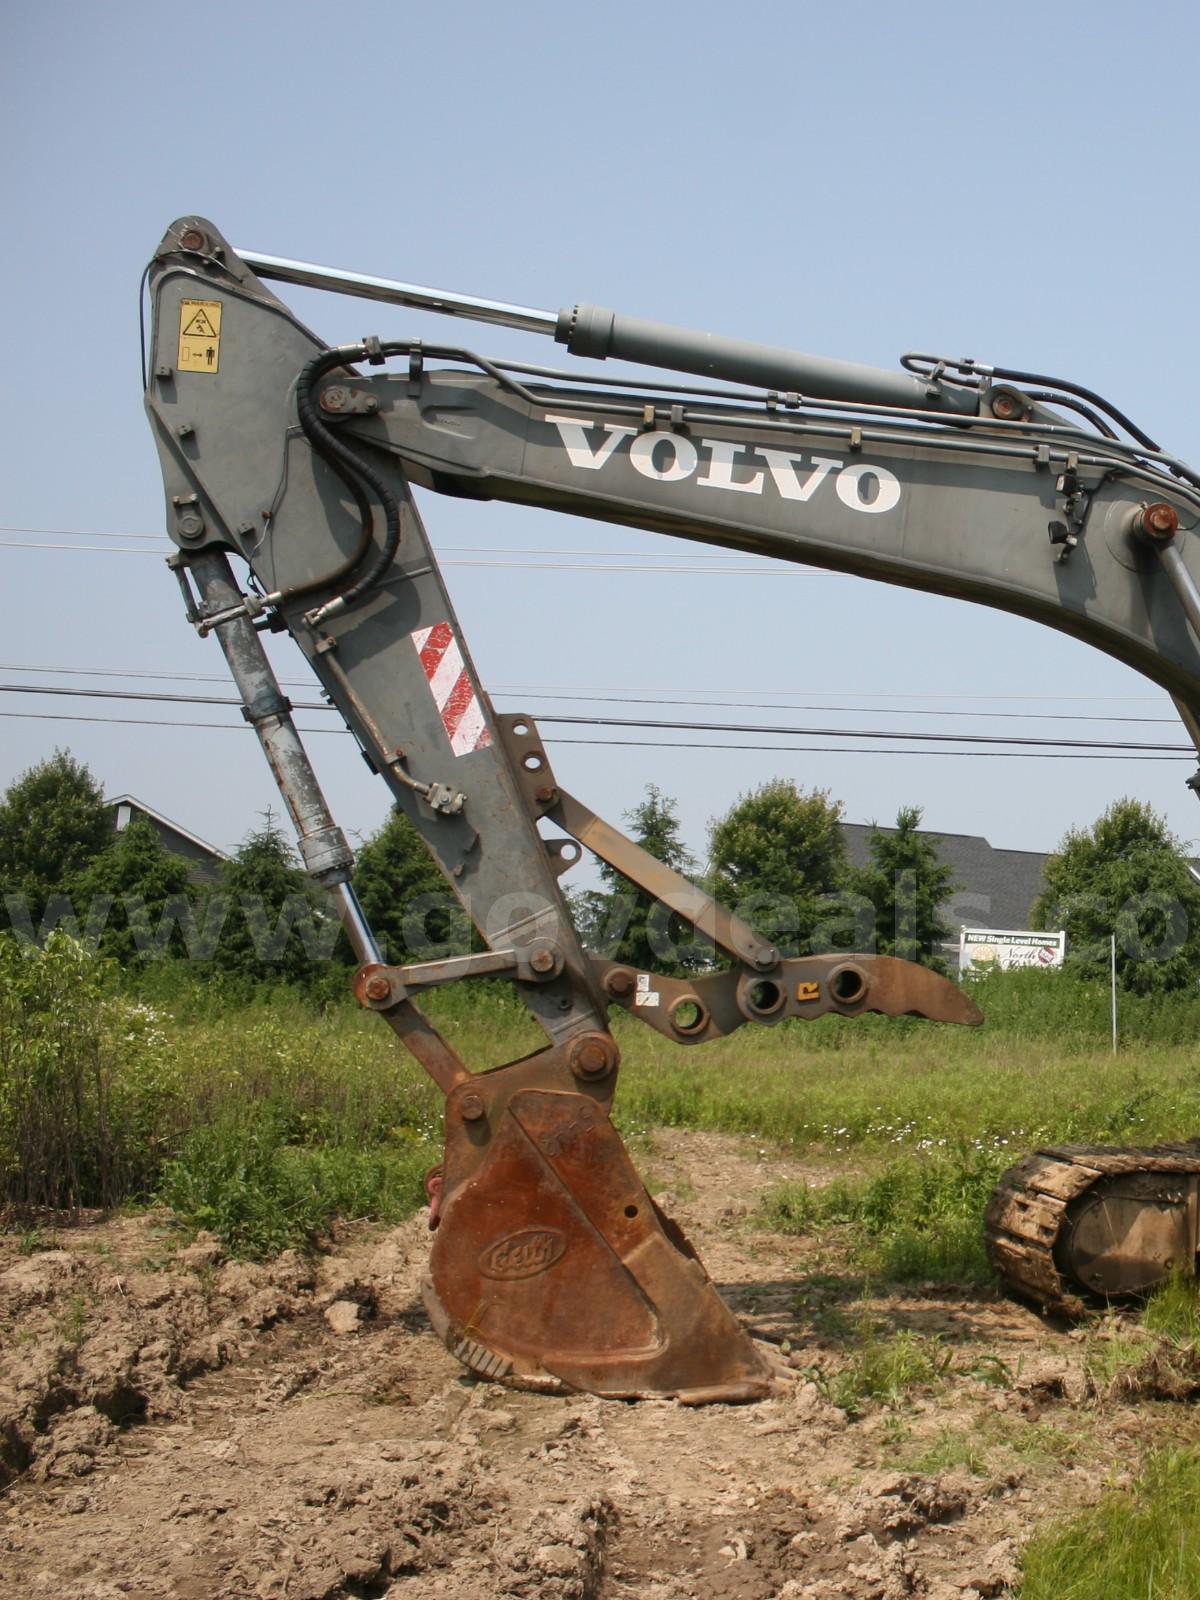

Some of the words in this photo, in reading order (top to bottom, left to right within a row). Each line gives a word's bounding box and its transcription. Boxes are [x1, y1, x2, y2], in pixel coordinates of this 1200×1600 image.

[544, 414, 901, 514] VOLVO
[967, 934, 986, 943] NEW
[987, 935, 1010, 944] Single
[1011, 938, 1032, 946] Level
[1032, 938, 1057, 947] Homes
[1007, 946, 1037, 960] North
